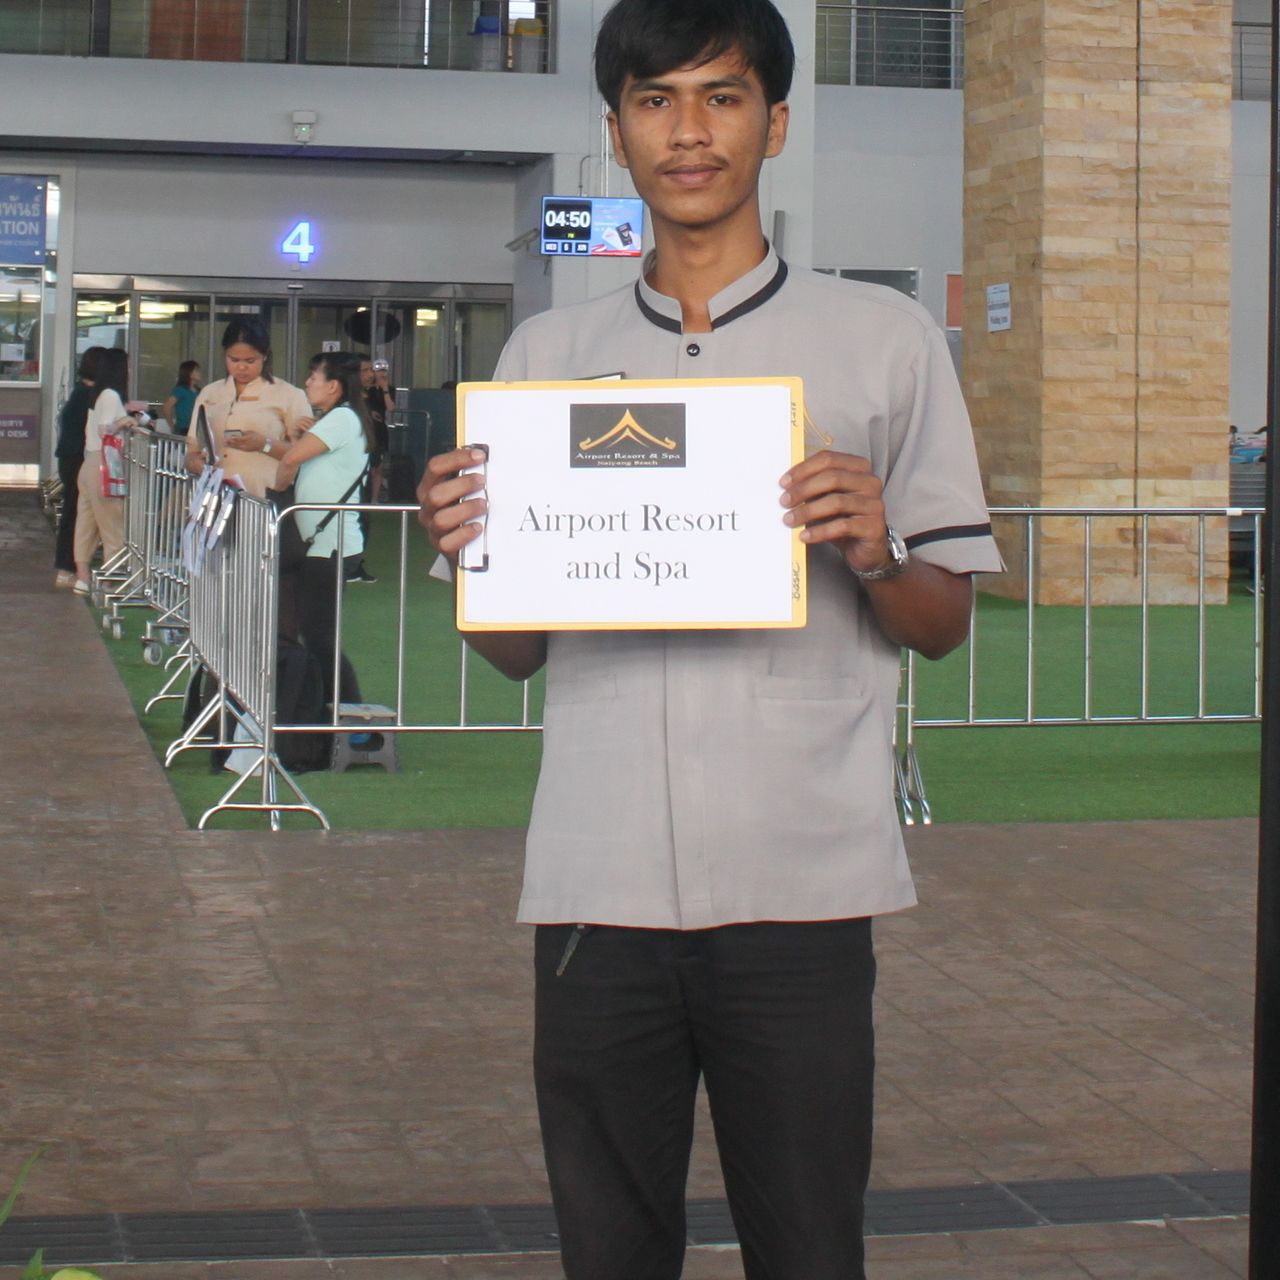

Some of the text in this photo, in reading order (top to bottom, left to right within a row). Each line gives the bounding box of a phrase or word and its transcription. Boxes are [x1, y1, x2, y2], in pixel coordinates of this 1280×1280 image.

[545, 210, 591, 228] 04:50
[282, 221, 315, 262] 4
[7, 430, 29, 439] DESK
[576, 453, 611, 461] Airport
[614, 452, 646, 460] Resort
[661, 452, 681, 461] Spa
[518, 504, 740, 538] Airport Resort
[566, 551, 690, 586] and Spa
